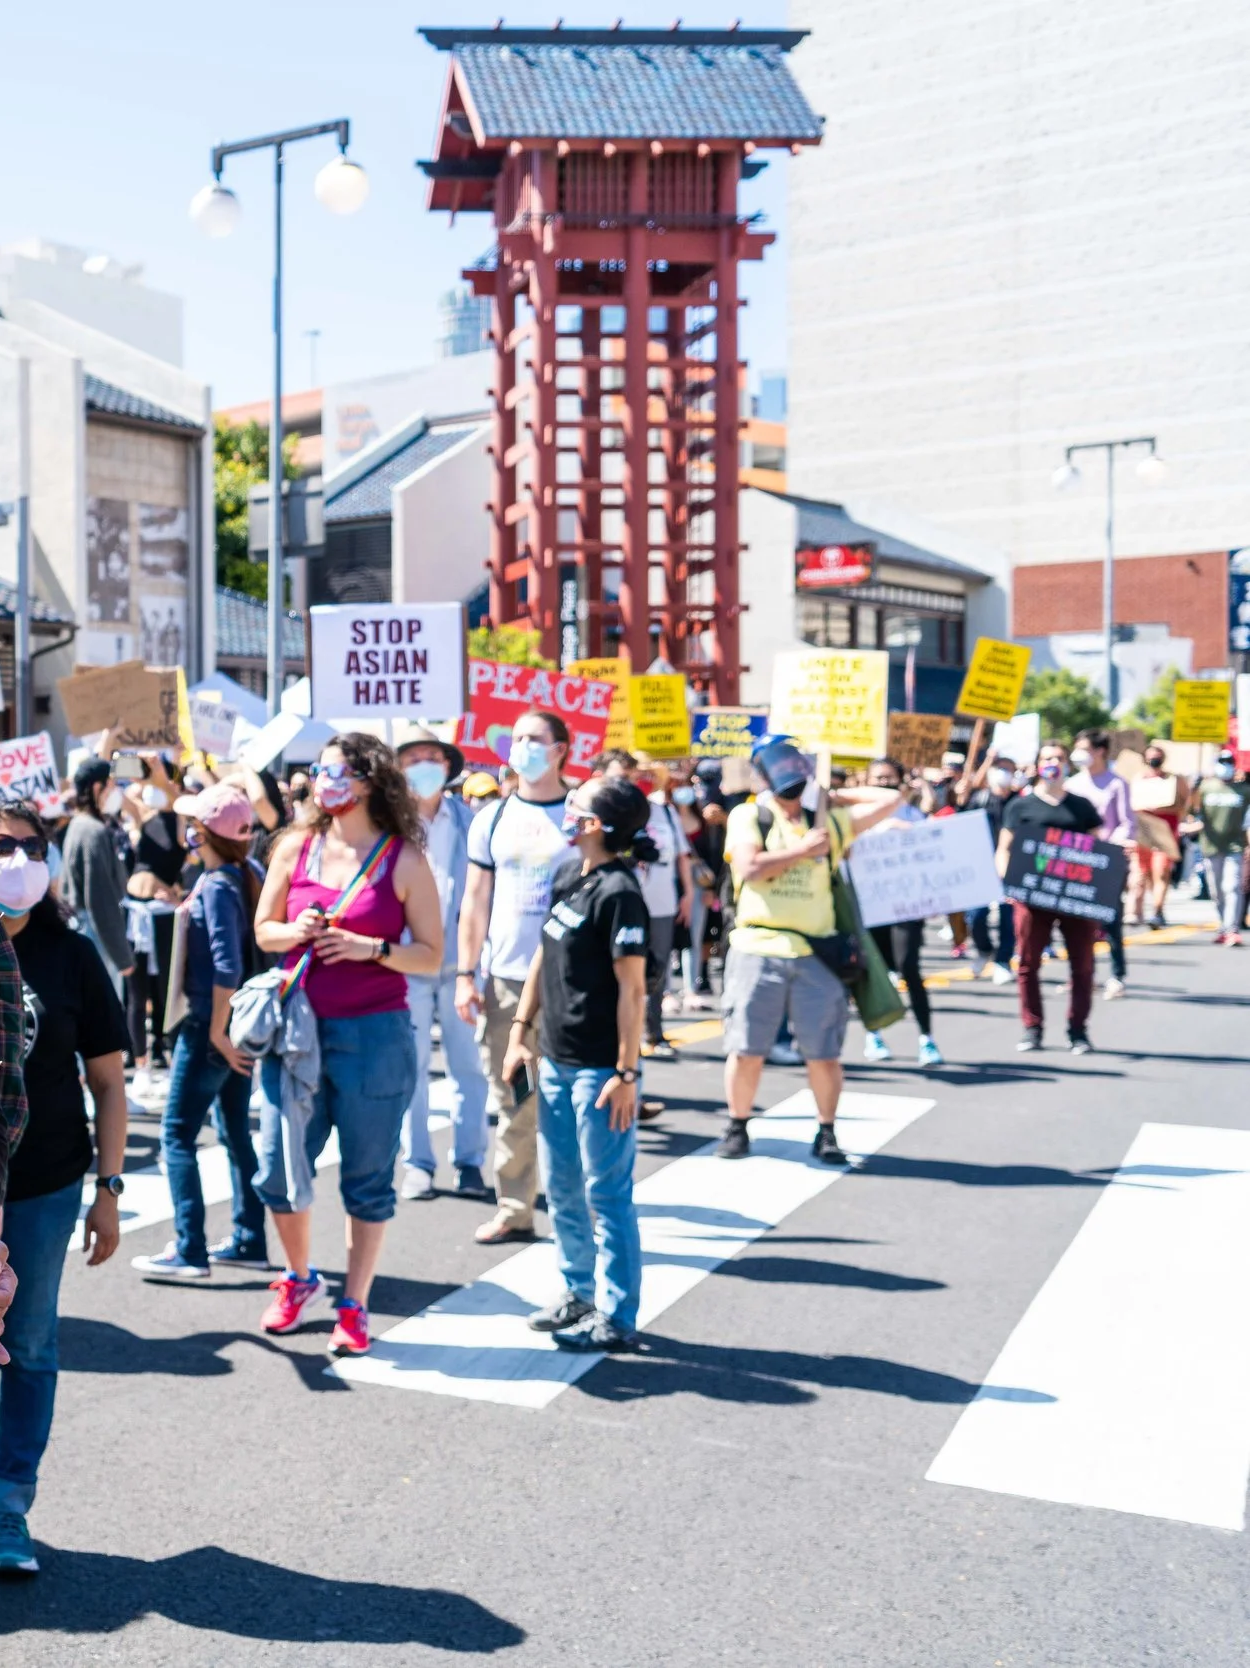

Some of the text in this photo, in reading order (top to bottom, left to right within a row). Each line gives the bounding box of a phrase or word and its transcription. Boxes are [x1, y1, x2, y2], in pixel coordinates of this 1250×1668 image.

[350, 619, 423, 645] STOP
[344, 650, 429, 675] ASIAN
[353, 679, 423, 705] HATE
[468, 660, 615, 718] PEACE
